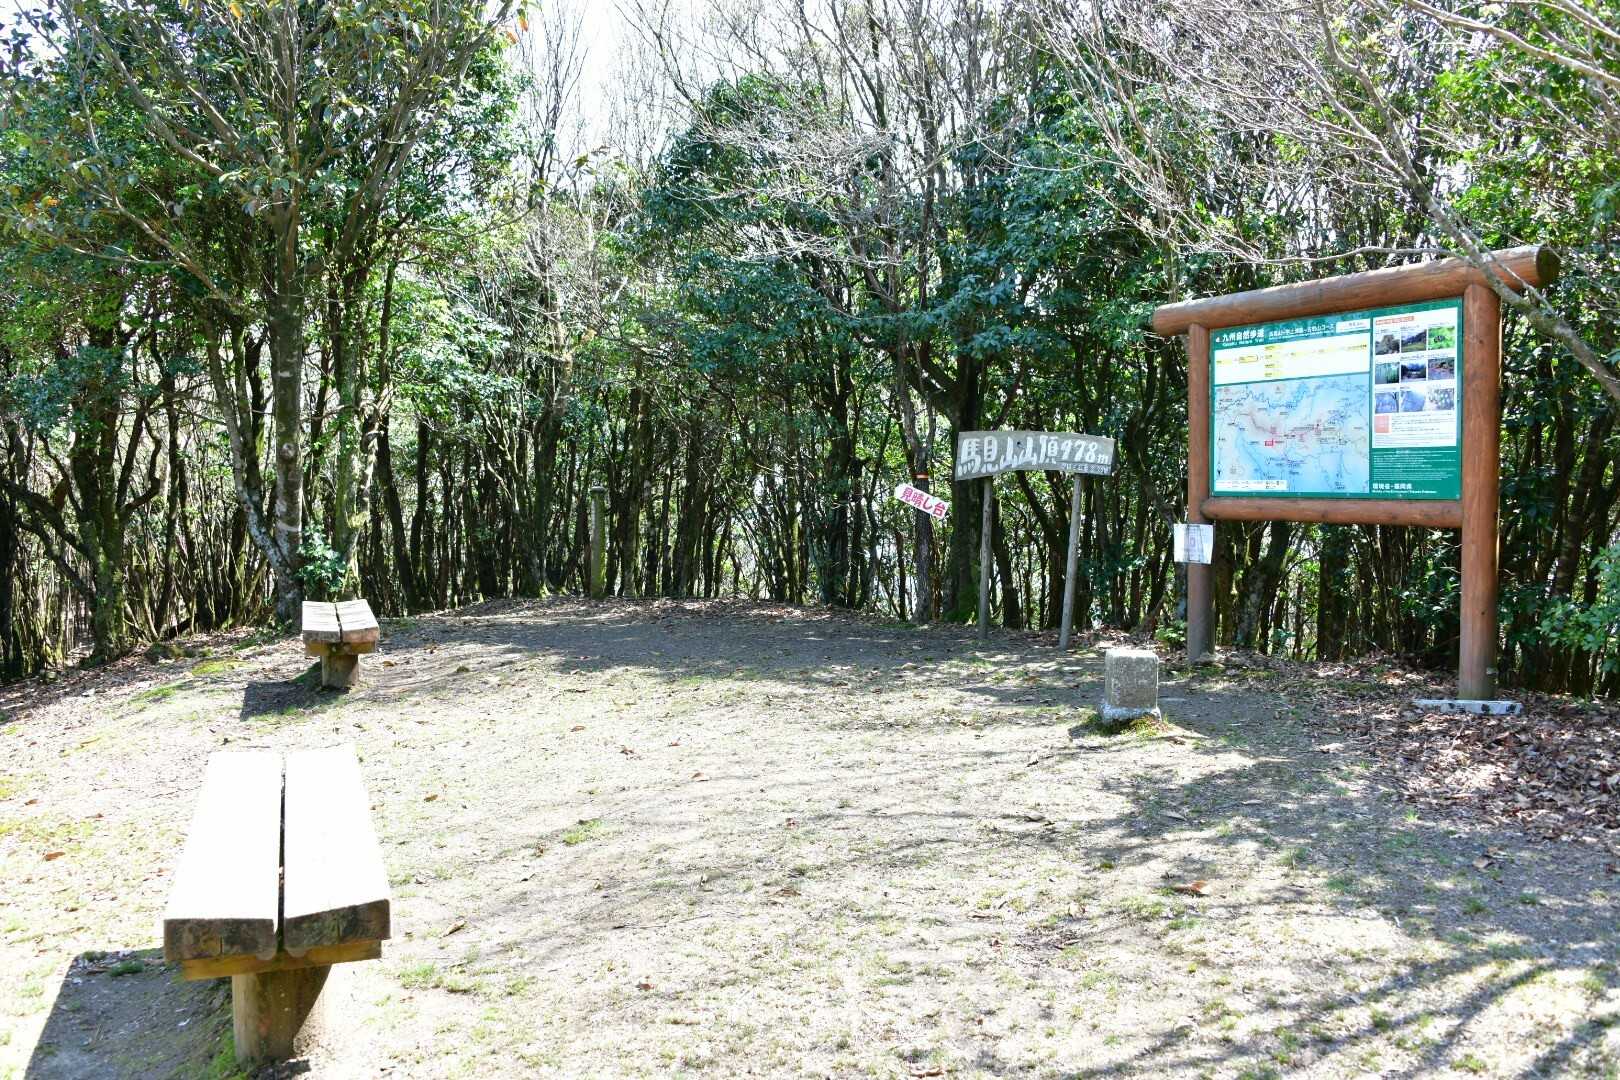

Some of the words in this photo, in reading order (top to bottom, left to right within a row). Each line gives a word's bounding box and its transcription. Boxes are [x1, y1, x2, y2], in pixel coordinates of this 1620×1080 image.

[1222, 328, 1264, 342] 九州自然歩道
[900, 487, 946, 516] 見晴し台
